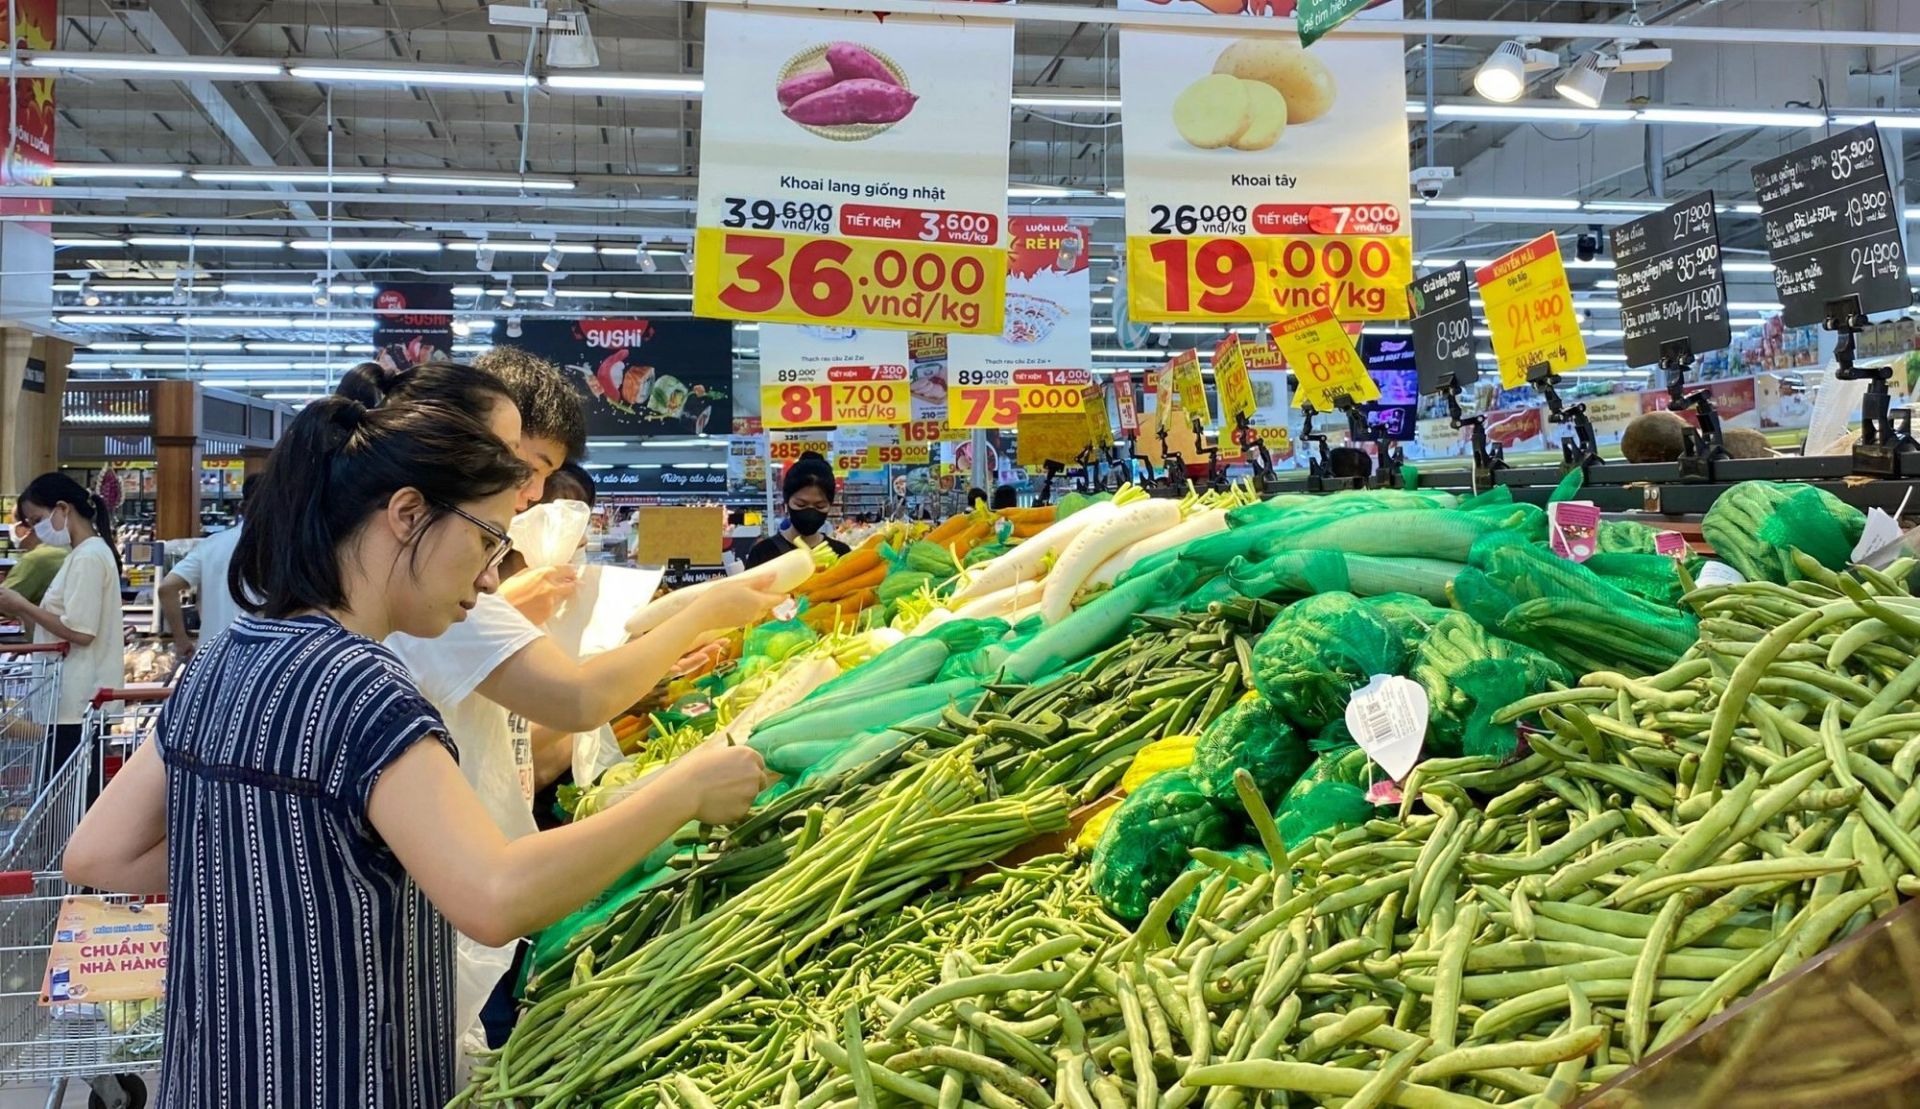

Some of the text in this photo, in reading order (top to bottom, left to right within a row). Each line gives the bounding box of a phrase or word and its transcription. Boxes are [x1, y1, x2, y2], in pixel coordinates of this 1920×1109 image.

[1315, 9, 1329, 26] tìm
[781, 176, 946, 202] Khoai lang giống nhật
[1231, 174, 1297, 188] Khoai tây
[846, 212, 990, 241] TIẾT KIỆM 3.600
[1026, 224, 1050, 232] LUÔN
[1257, 205, 1398, 233] TIẾT KIỆM 7.000
[948, 231, 988, 244] vnđ/kg
[718, 234, 985, 317] 36.000
[1150, 238, 1391, 313] 19.000
[862, 292, 980, 328] vnđ/kg
[1273, 281, 1385, 313] vnđ/kg
[781, 385, 893, 423] 81.700
[838, 404, 896, 420] vnđ/kg
[80, 937, 145, 958] CHUẨN
[80, 956, 168, 974] NHÀ HÀNG
